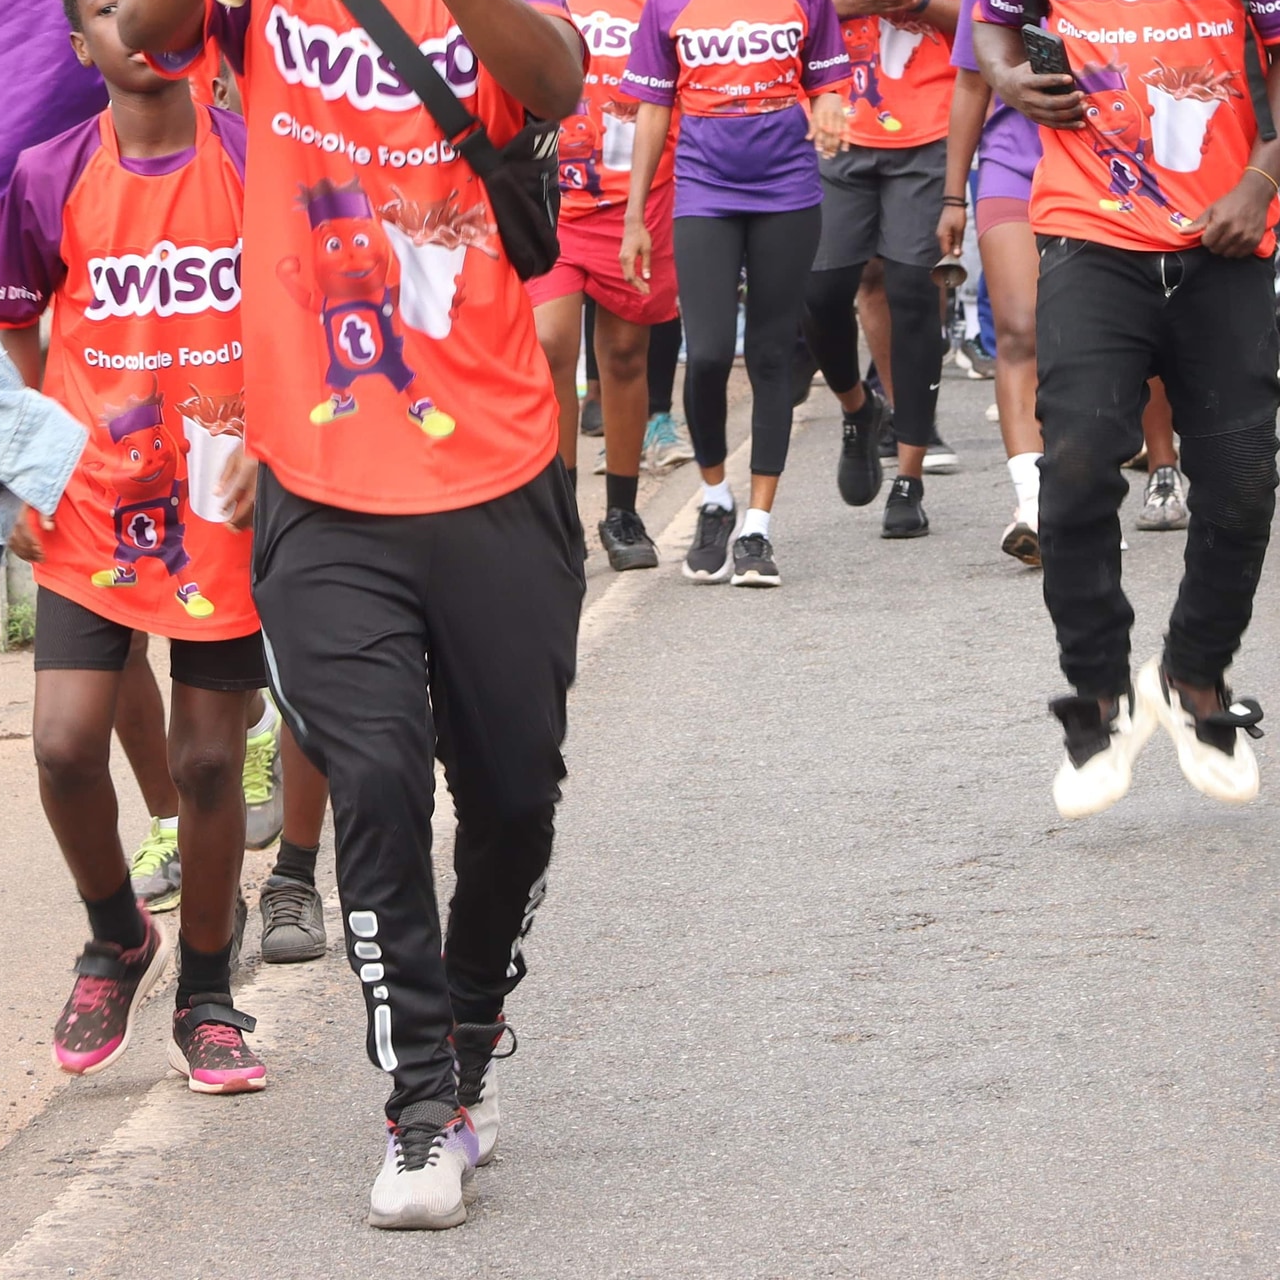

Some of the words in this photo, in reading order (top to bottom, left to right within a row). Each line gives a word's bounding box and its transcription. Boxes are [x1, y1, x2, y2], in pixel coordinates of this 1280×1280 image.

[679, 24, 803, 61] twisco
[1142, 22, 1192, 44] Food
[378, 140, 439, 168] Food
[177, 343, 230, 367] Food
